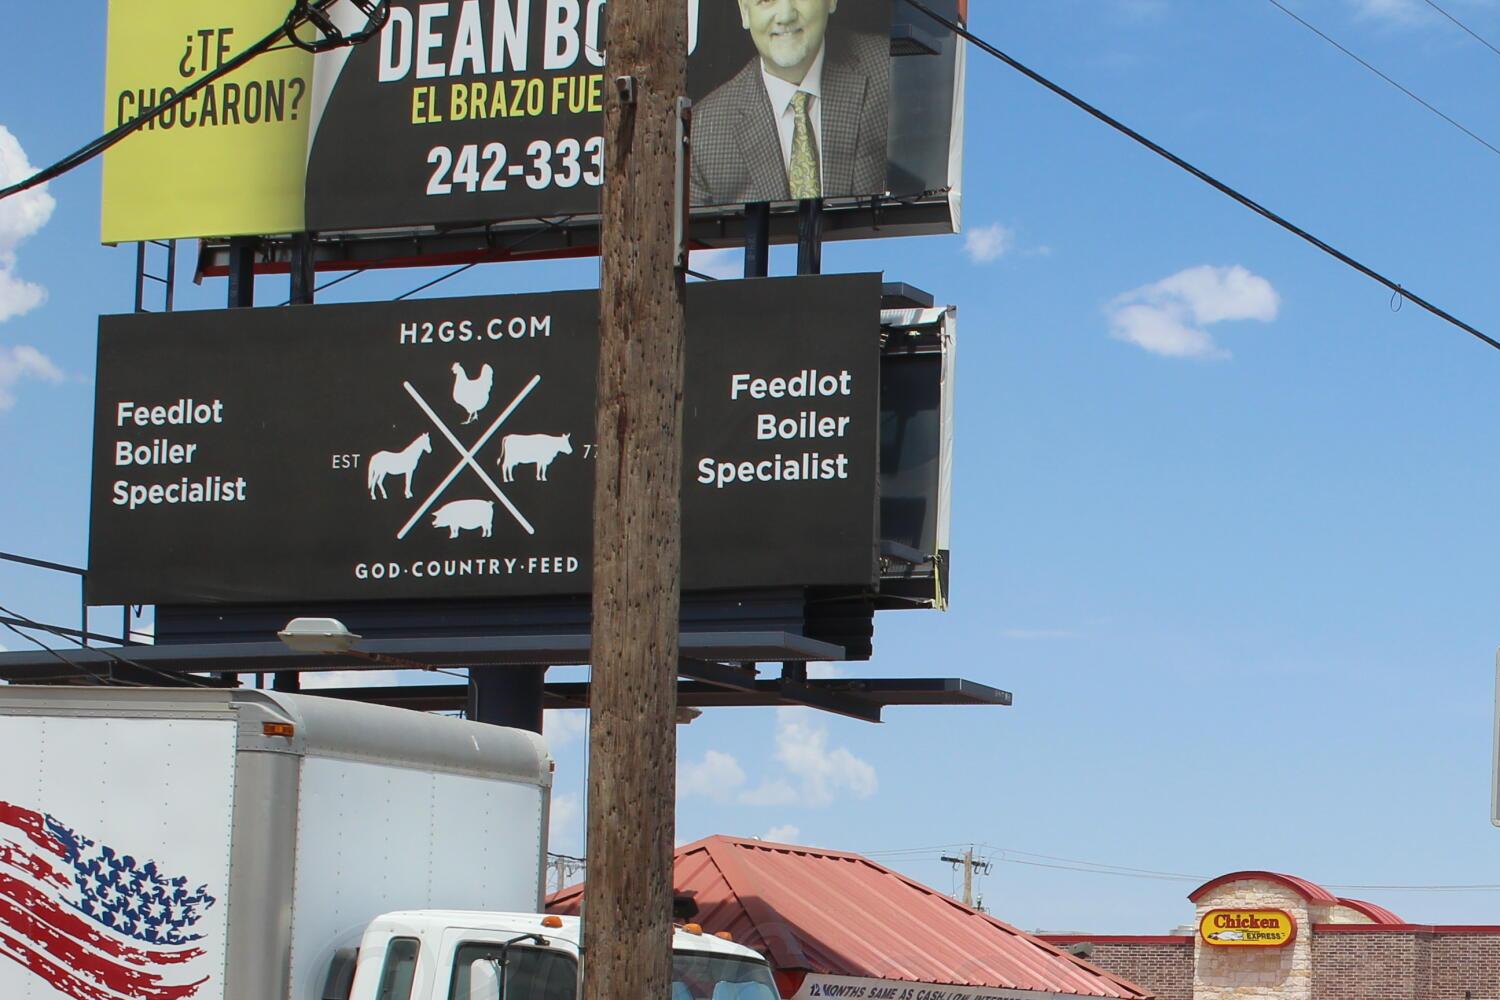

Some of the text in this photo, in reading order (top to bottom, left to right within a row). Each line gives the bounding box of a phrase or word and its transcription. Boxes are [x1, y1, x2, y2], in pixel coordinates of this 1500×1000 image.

[179, 28, 234, 78] ¿TE
[378, 0, 537, 83] DEAN
[118, 78, 306, 131] CHOCARON?
[412, 74, 603, 124] EL BRAZO FUE
[426, 137, 605, 195] 242-333
[399, 315, 551, 344] H2GS.COM
[731, 369, 852, 400] Feedlot
[116, 398, 224, 427] Feedlot
[756, 411, 850, 440] Boiler
[115, 438, 197, 466] Boiler
[332, 454, 361, 469] EST
[697, 452, 849, 489] Specialist
[112, 476, 247, 510] Specialist
[1213, 913, 1280, 929] Chicken
[1246, 932, 1281, 940] EXPRESS
[810, 984, 821, 997] 12
[823, 984, 867, 998] MONTHS
[868, 987, 898, 1000] SAME
[900, 989, 914, 1000] AS
